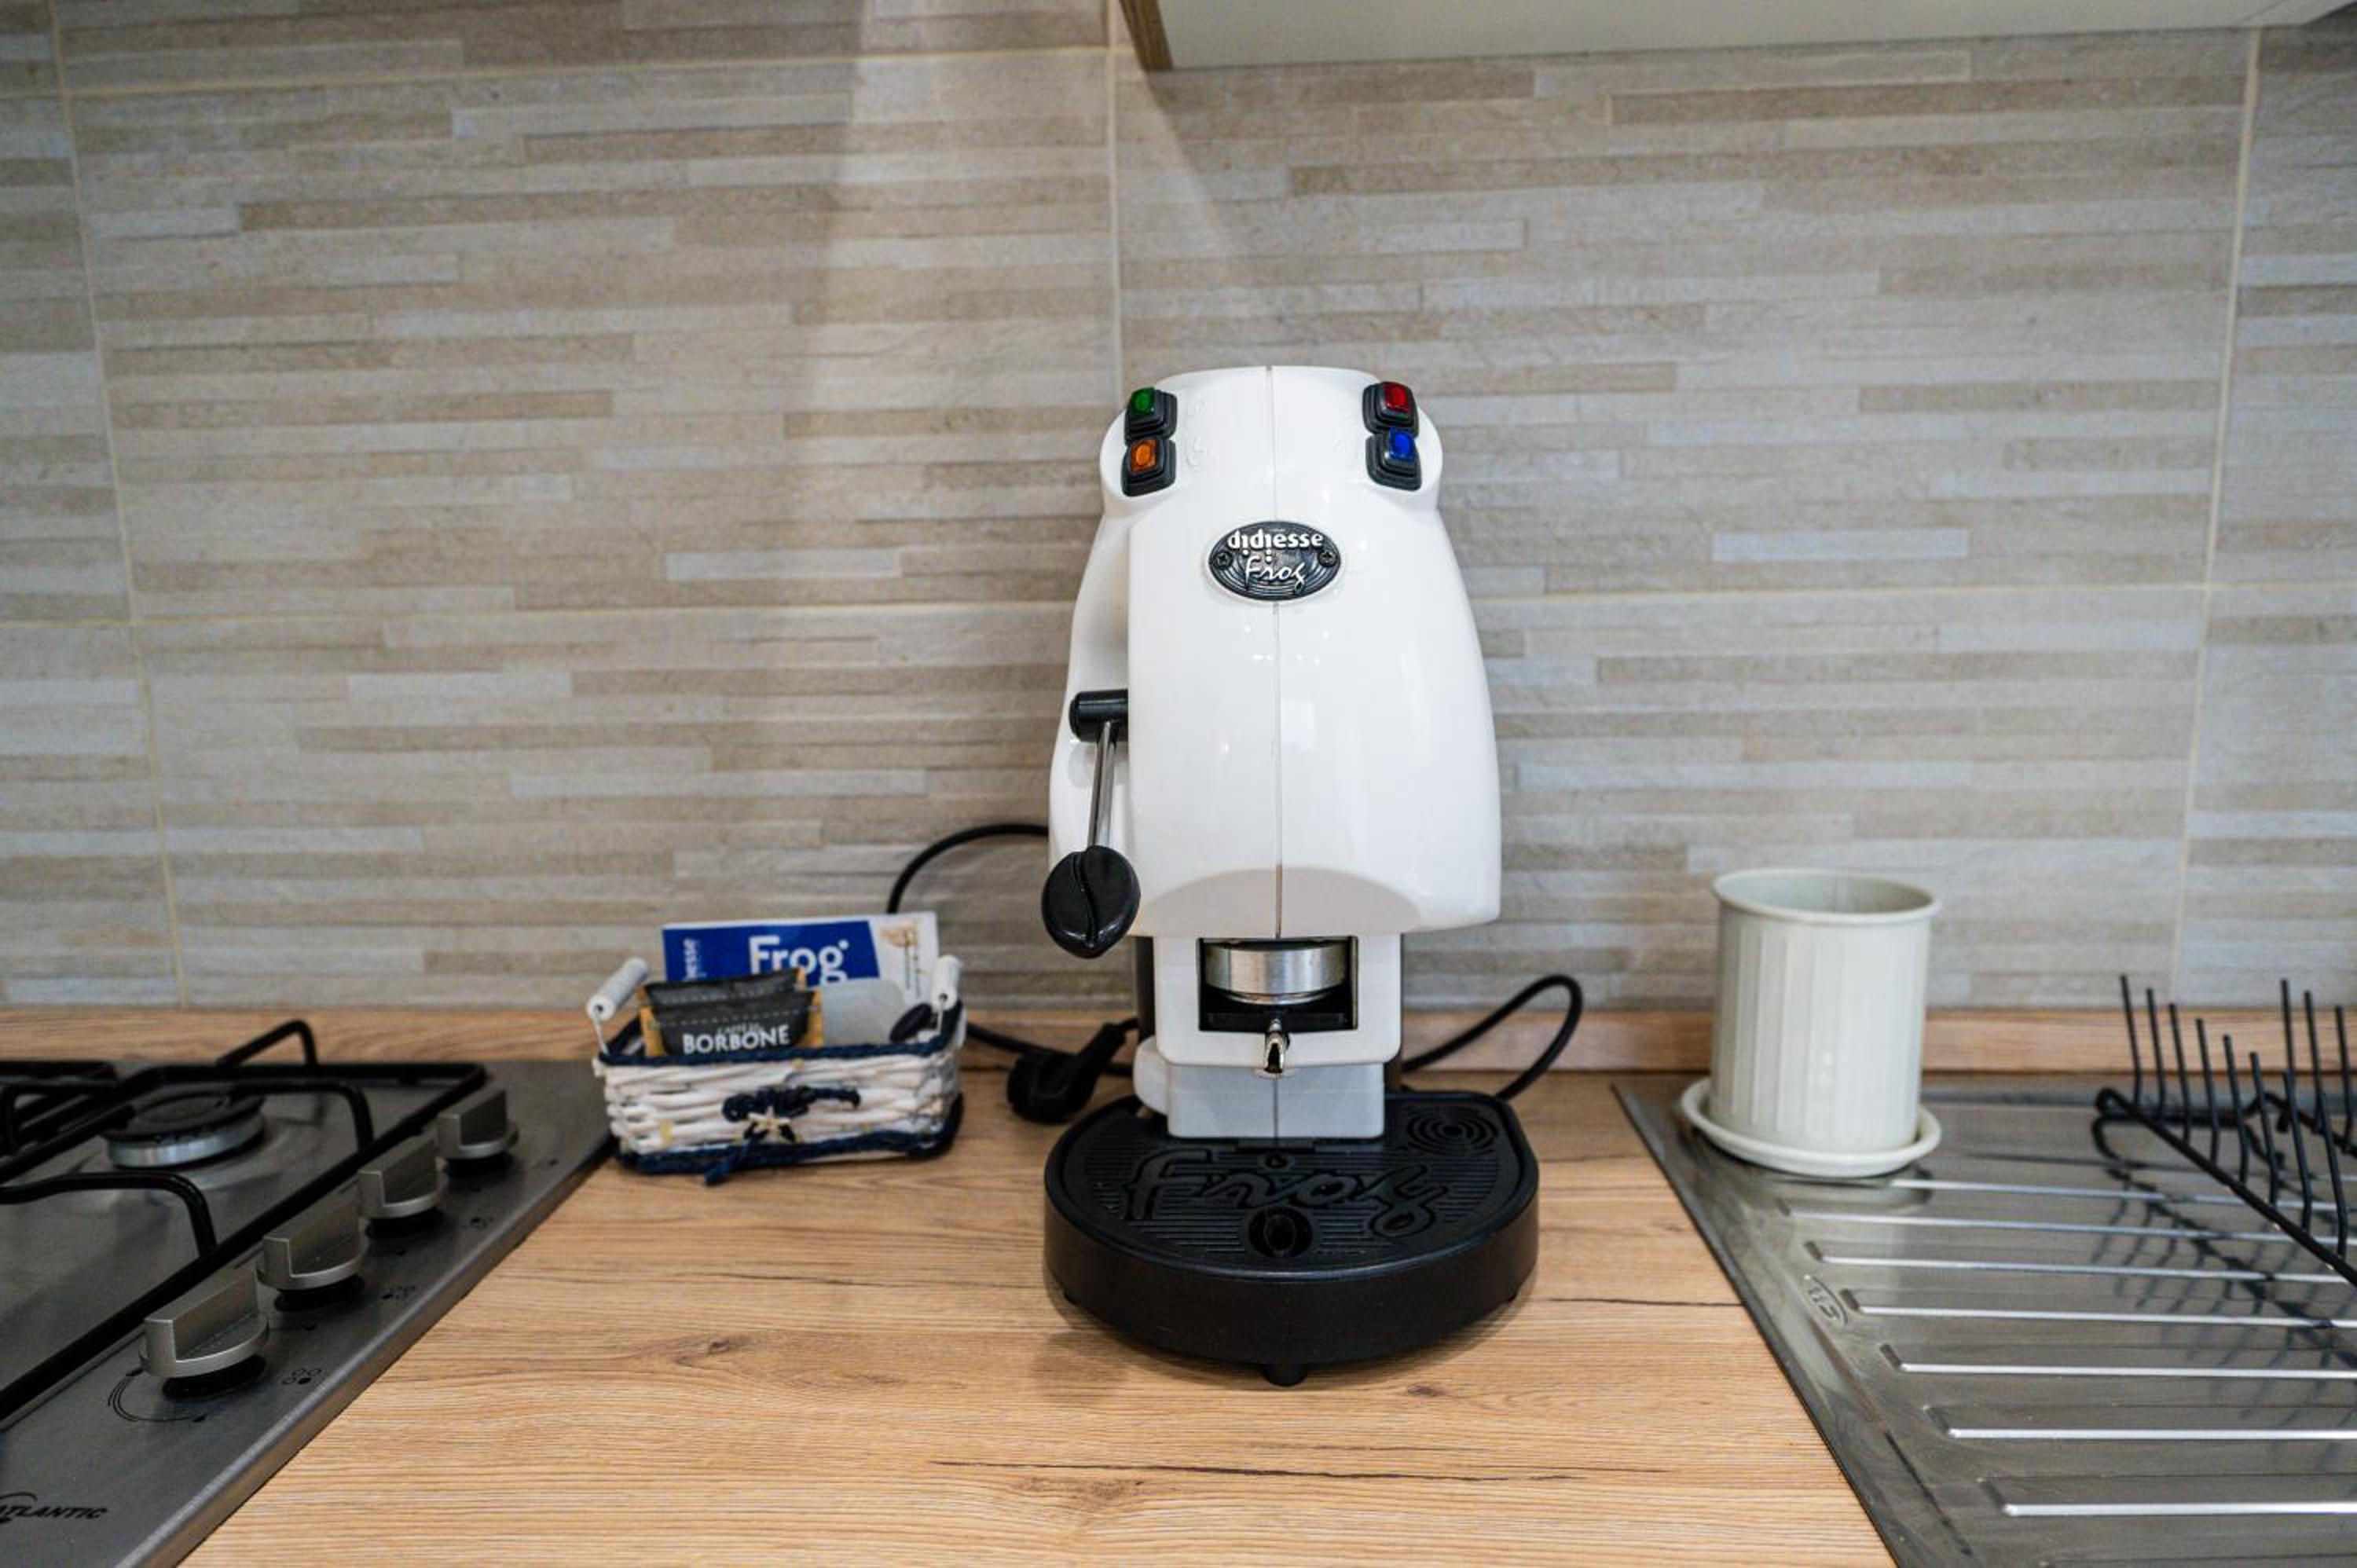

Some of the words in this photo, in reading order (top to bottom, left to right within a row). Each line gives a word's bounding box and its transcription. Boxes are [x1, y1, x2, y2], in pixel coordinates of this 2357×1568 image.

[1227, 529, 1325, 551] didiesse
[1244, 555, 1306, 592] Frog
[749, 935, 849, 987] Frog
[682, 1024, 790, 1055] BORBONE
[1121, 1149, 1449, 1237] Frog
